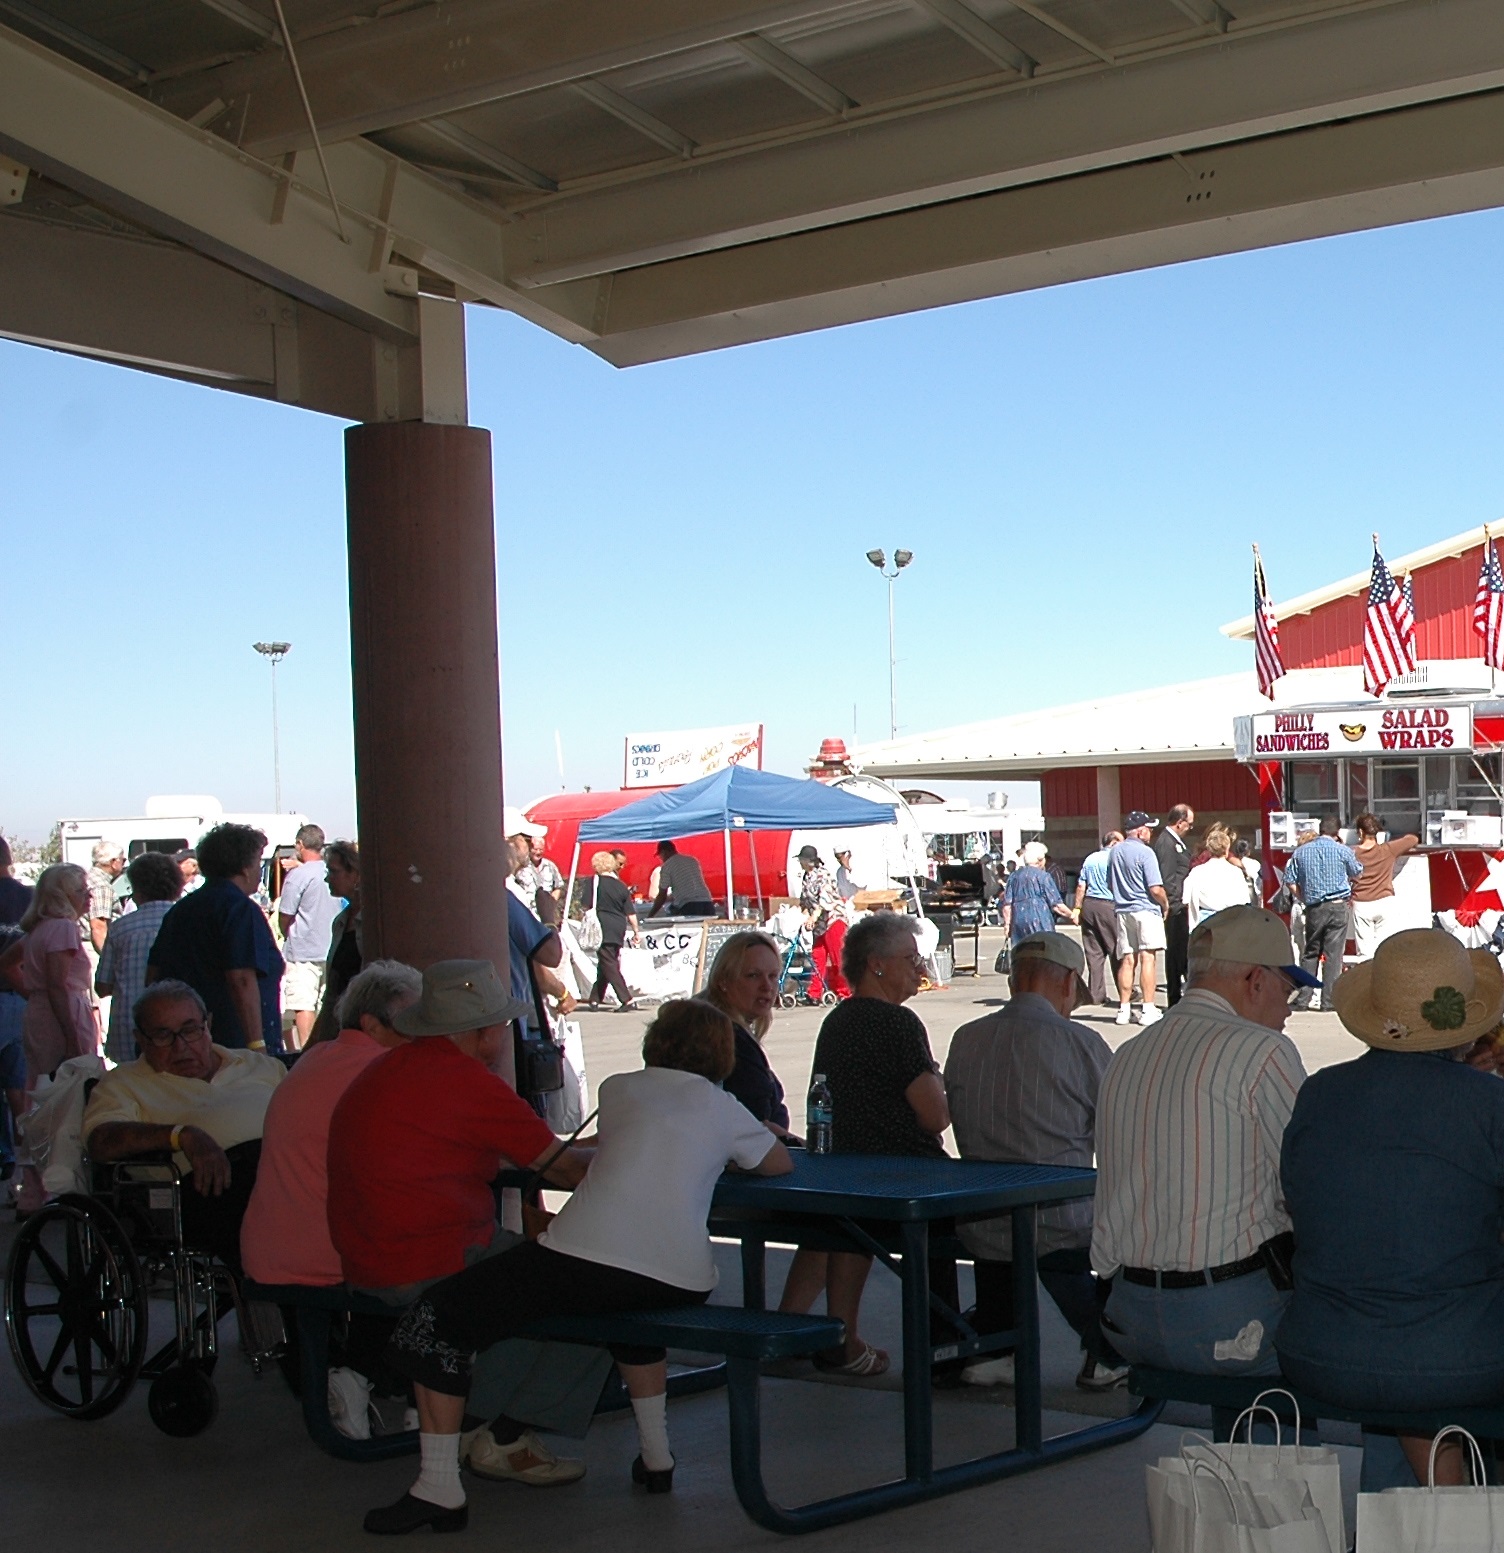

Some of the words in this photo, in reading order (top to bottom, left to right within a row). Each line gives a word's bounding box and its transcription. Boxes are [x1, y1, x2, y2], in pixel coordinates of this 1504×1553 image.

[1275, 713, 1315, 733] PHILLY
[1381, 708, 1450, 729] SALAD
[1256, 732, 1330, 752] SANDWICHES
[1378, 729, 1454, 750] WRAPS
